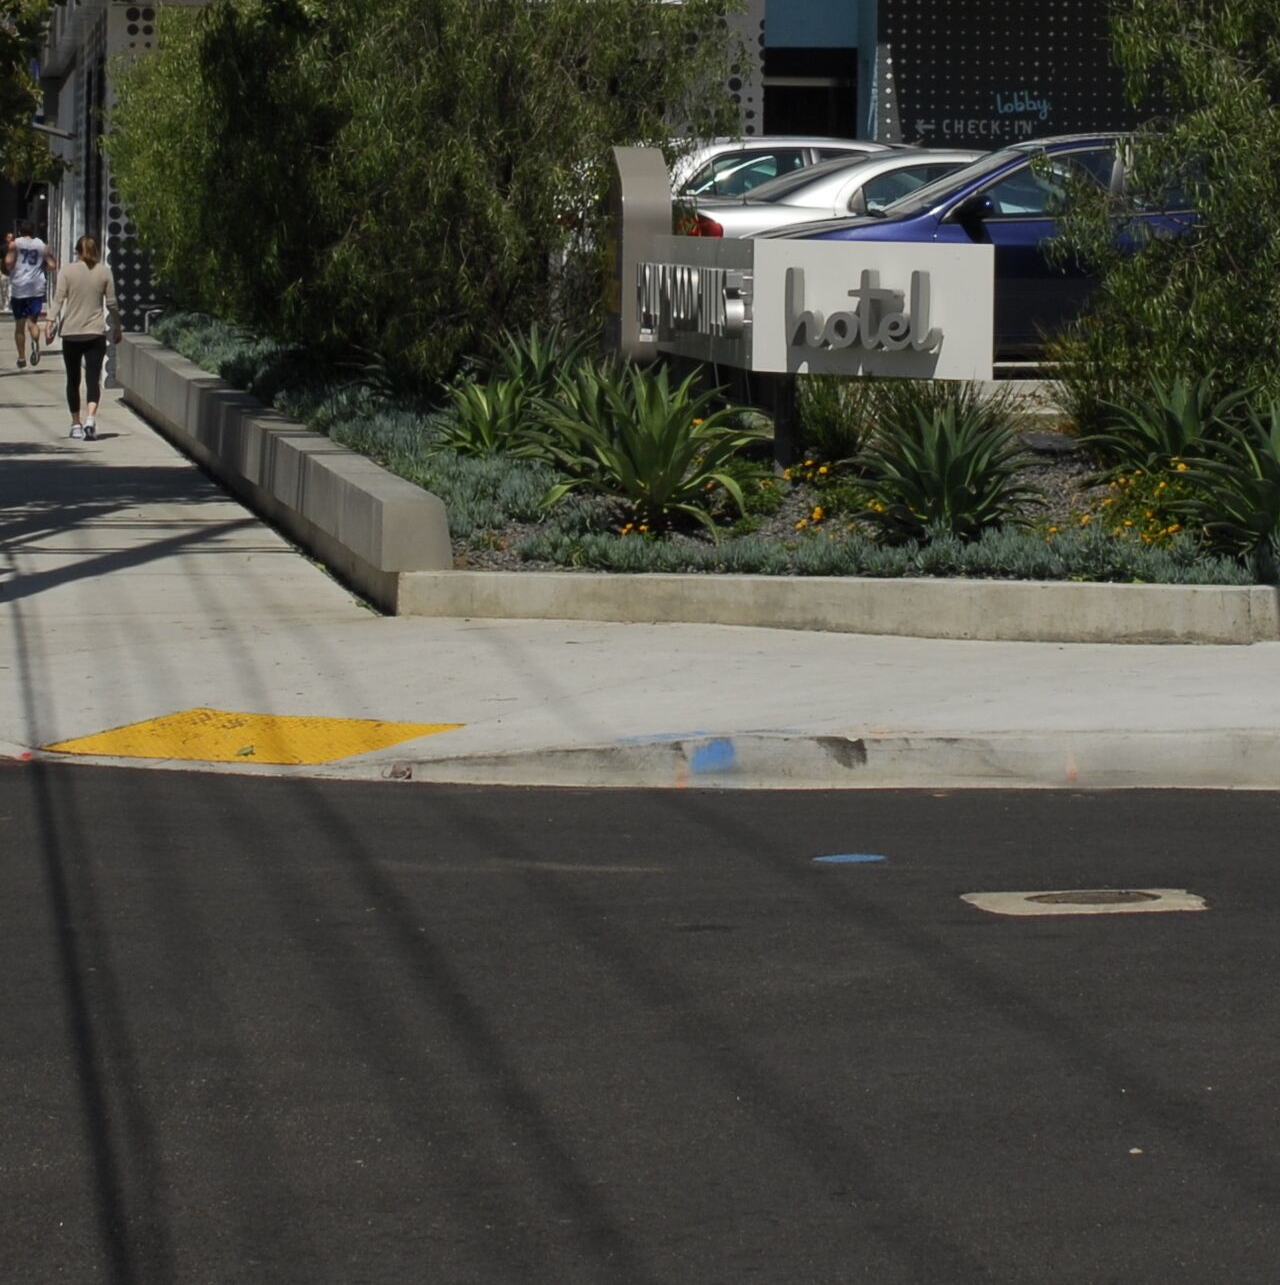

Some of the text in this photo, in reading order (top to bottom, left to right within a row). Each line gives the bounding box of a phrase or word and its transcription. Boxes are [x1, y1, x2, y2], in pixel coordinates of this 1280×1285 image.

[996, 90, 1051, 120] lobby
[943, 119, 1033, 135] CHECK-IN
[785, 267, 944, 351] hotel
